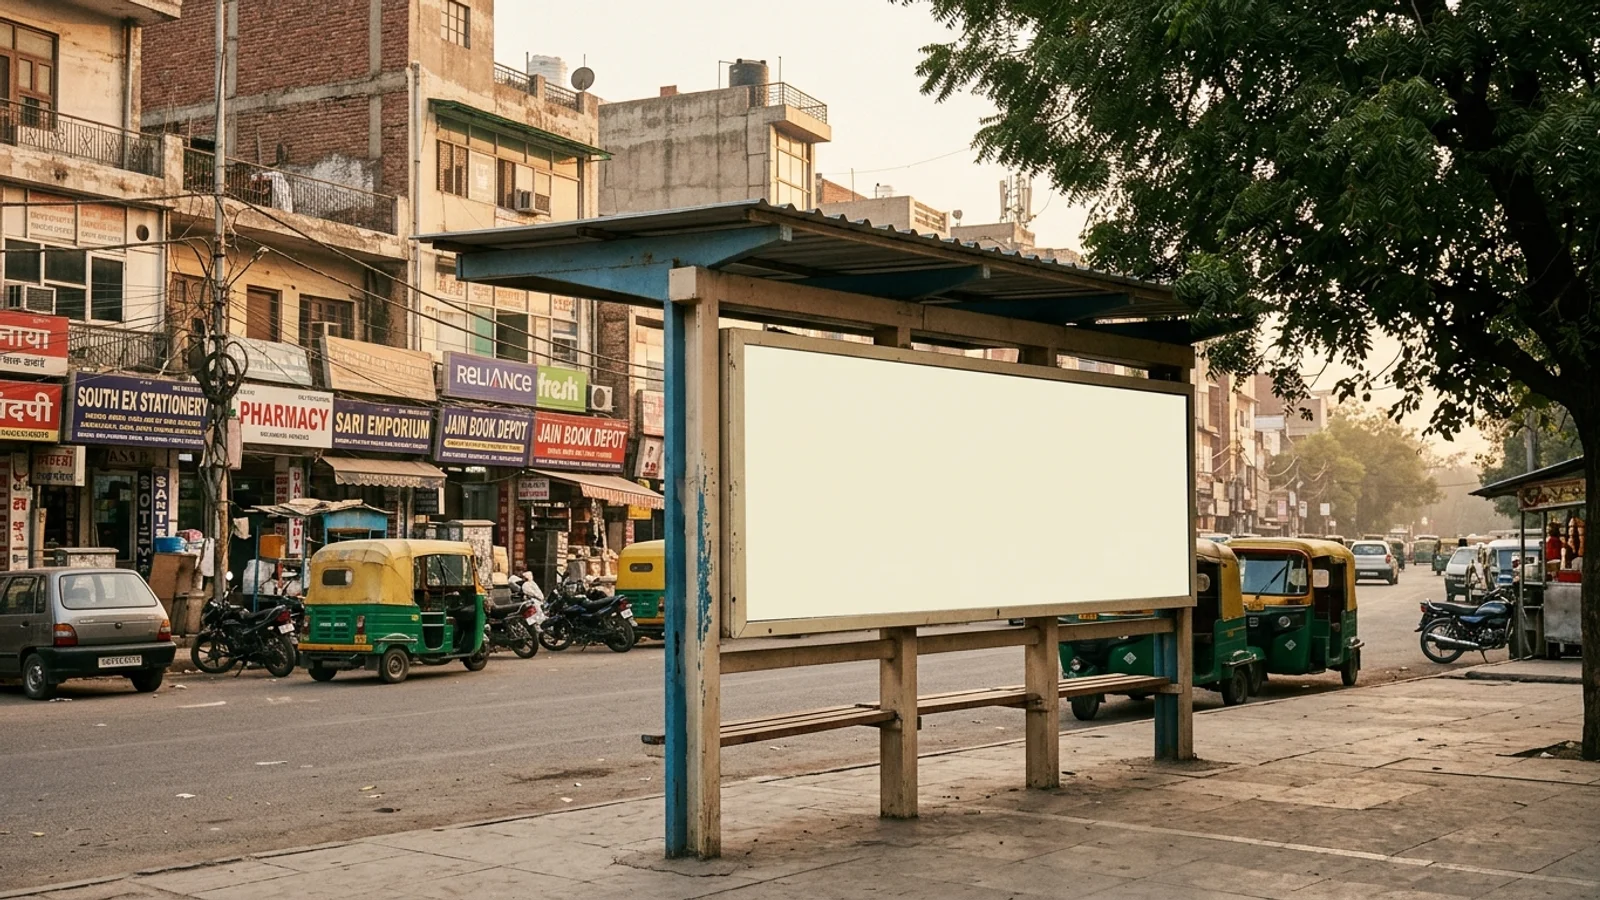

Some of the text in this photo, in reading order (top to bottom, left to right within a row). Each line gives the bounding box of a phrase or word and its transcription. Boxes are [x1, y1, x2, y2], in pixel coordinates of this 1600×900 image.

[77, 386, 209, 417] SOUTH EX STATIONERY
[537, 373, 579, 402] fresh
[239, 401, 329, 431] PHARMACY
[335, 411, 430, 440] SARI EMPORIUM
[444, 415, 529, 440] JAIN BOOK DEPOT
[537, 423, 626, 449] JAIN BOOK DEPOT
